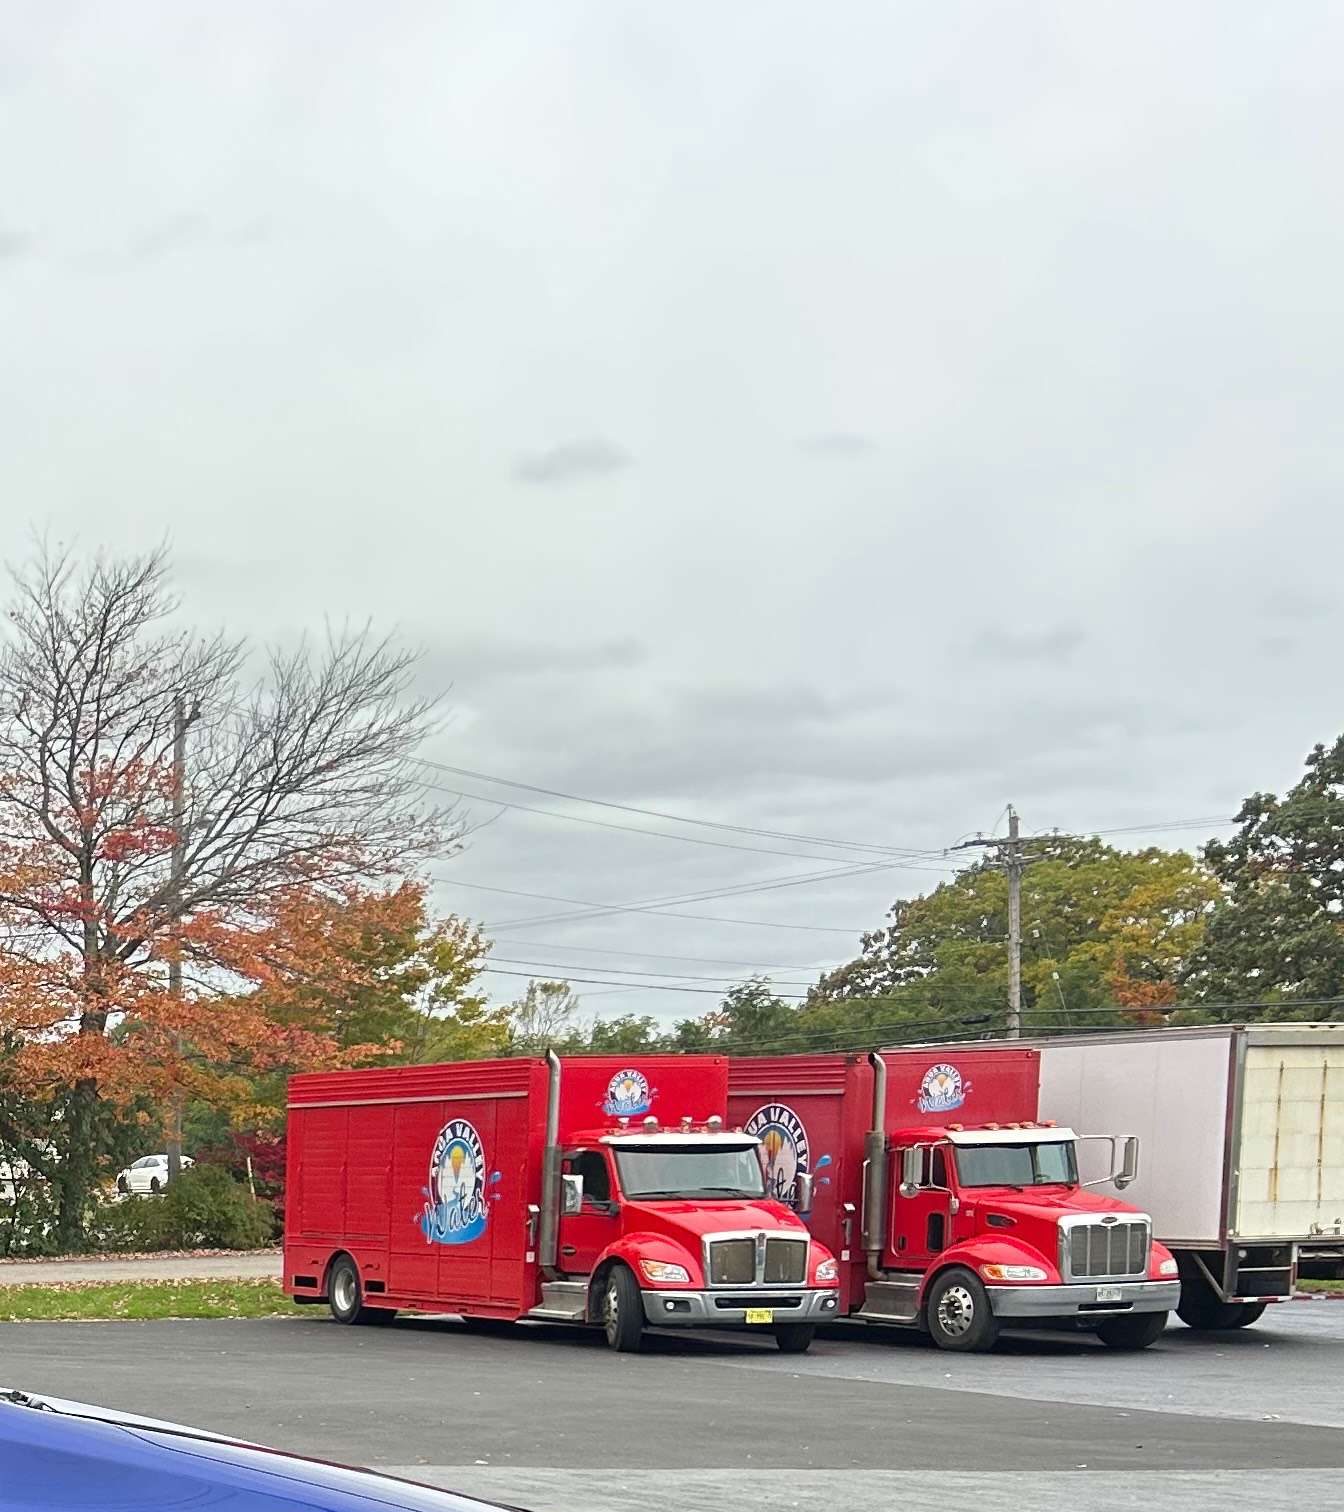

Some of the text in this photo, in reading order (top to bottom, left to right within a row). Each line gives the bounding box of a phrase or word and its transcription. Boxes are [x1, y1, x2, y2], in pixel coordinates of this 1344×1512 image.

[431, 1122, 484, 1180] AQUA VALLEY
[748, 1107, 808, 1168] UA VALLEY
[424, 1182, 490, 1244] Water
